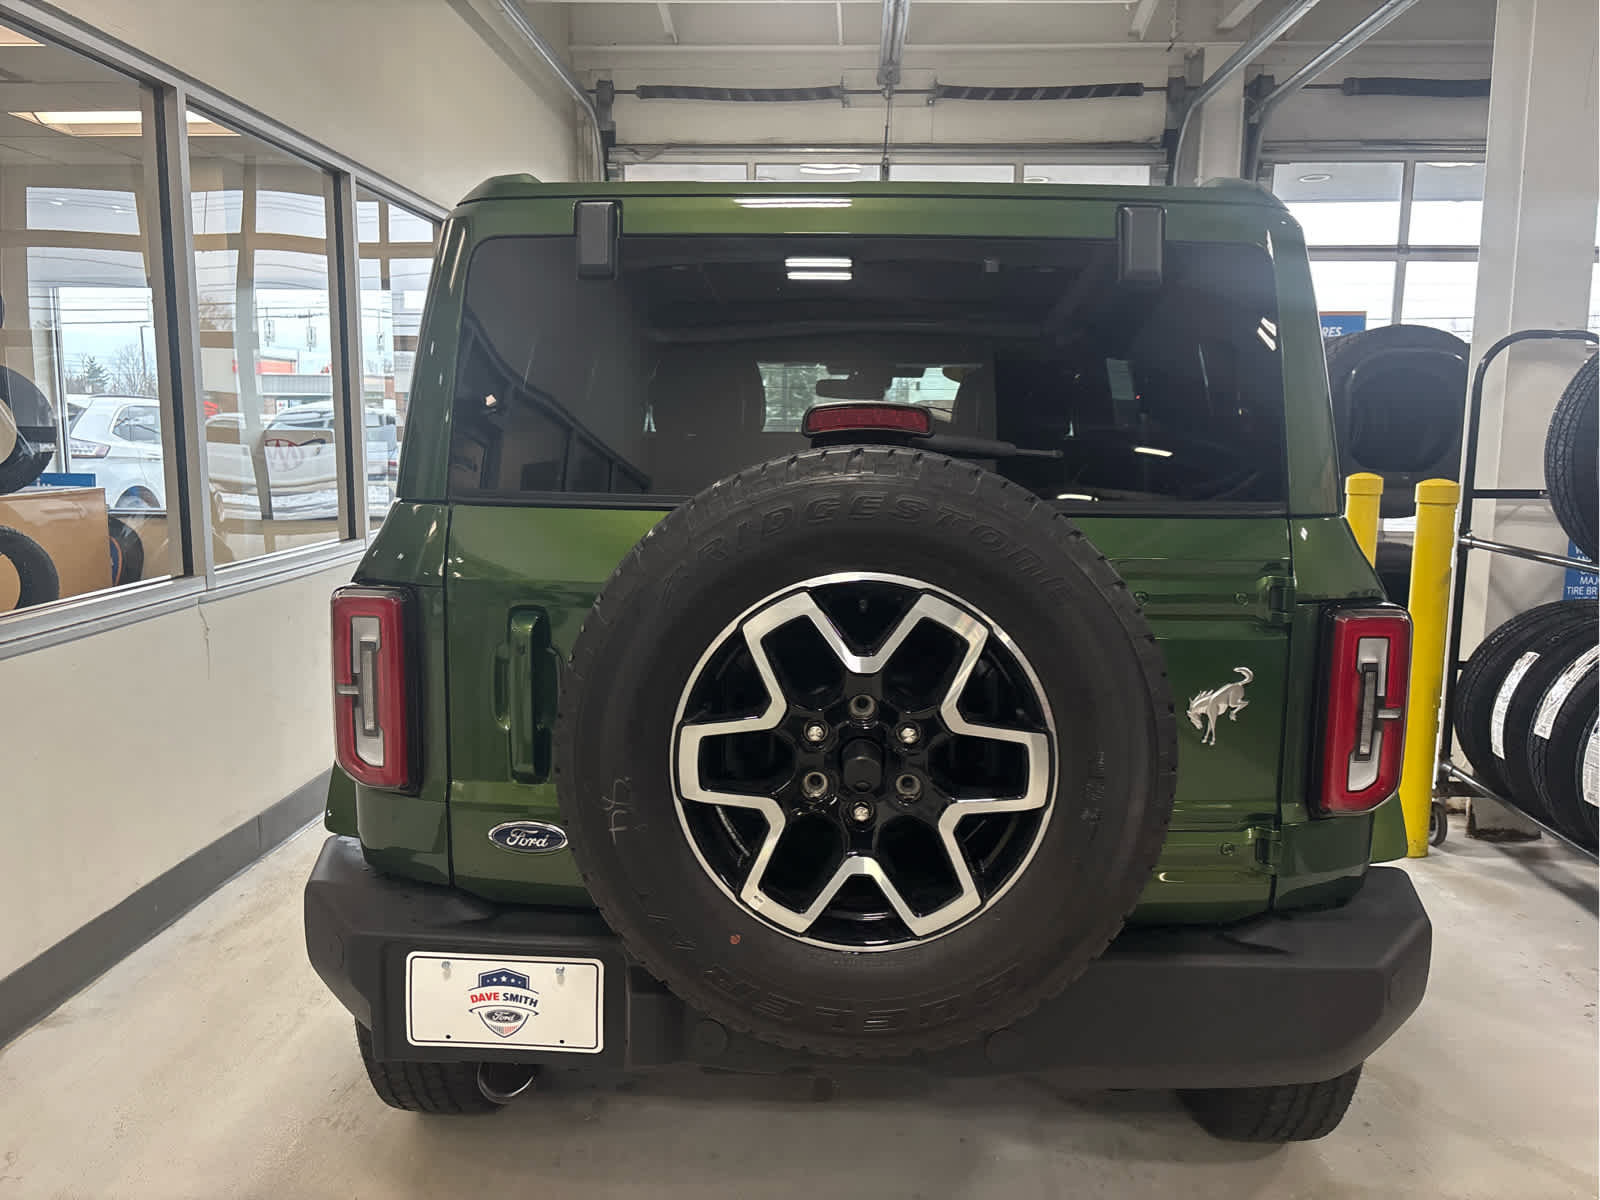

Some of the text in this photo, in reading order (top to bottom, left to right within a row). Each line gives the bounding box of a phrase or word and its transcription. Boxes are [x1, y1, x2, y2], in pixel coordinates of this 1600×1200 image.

[1567, 586, 1584, 595] TIRE
[506, 828, 550, 848] Ford
[470, 992, 538, 1008] DAVE SMITH
[491, 1011, 515, 1021] Ford
